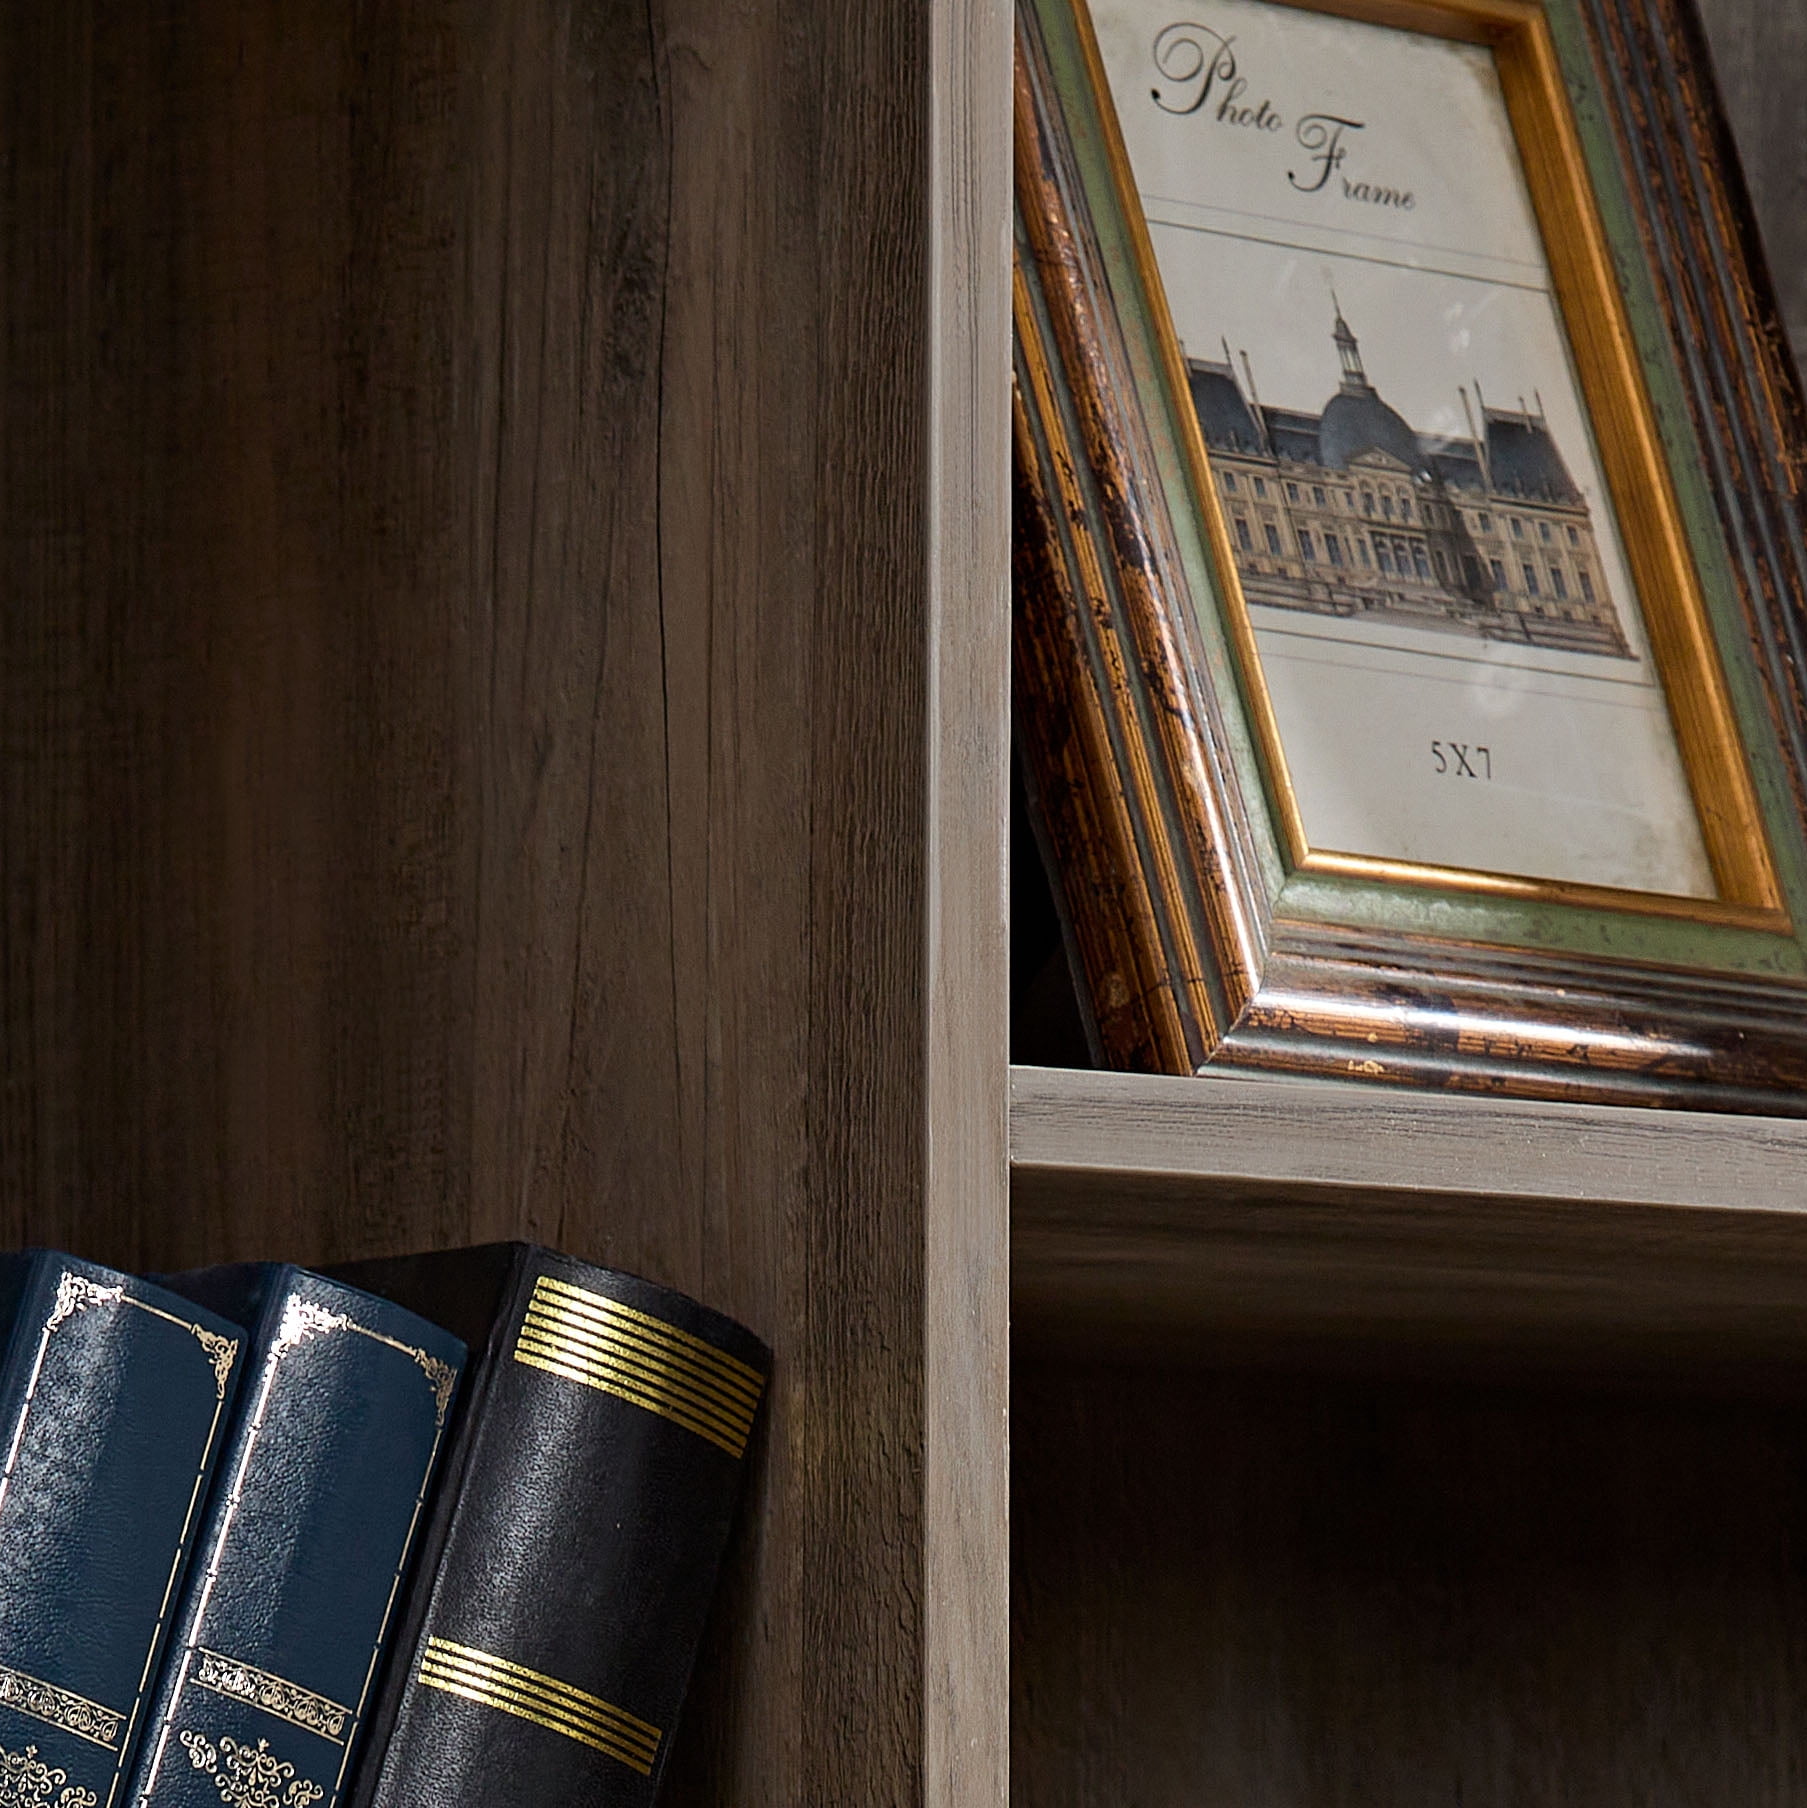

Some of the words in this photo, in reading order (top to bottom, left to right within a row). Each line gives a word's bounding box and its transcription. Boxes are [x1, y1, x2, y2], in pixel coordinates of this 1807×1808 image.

[1151, 21, 1283, 132] Photo
[1287, 114, 1416, 210] Frame
[1431, 740, 1491, 780] 5X7
